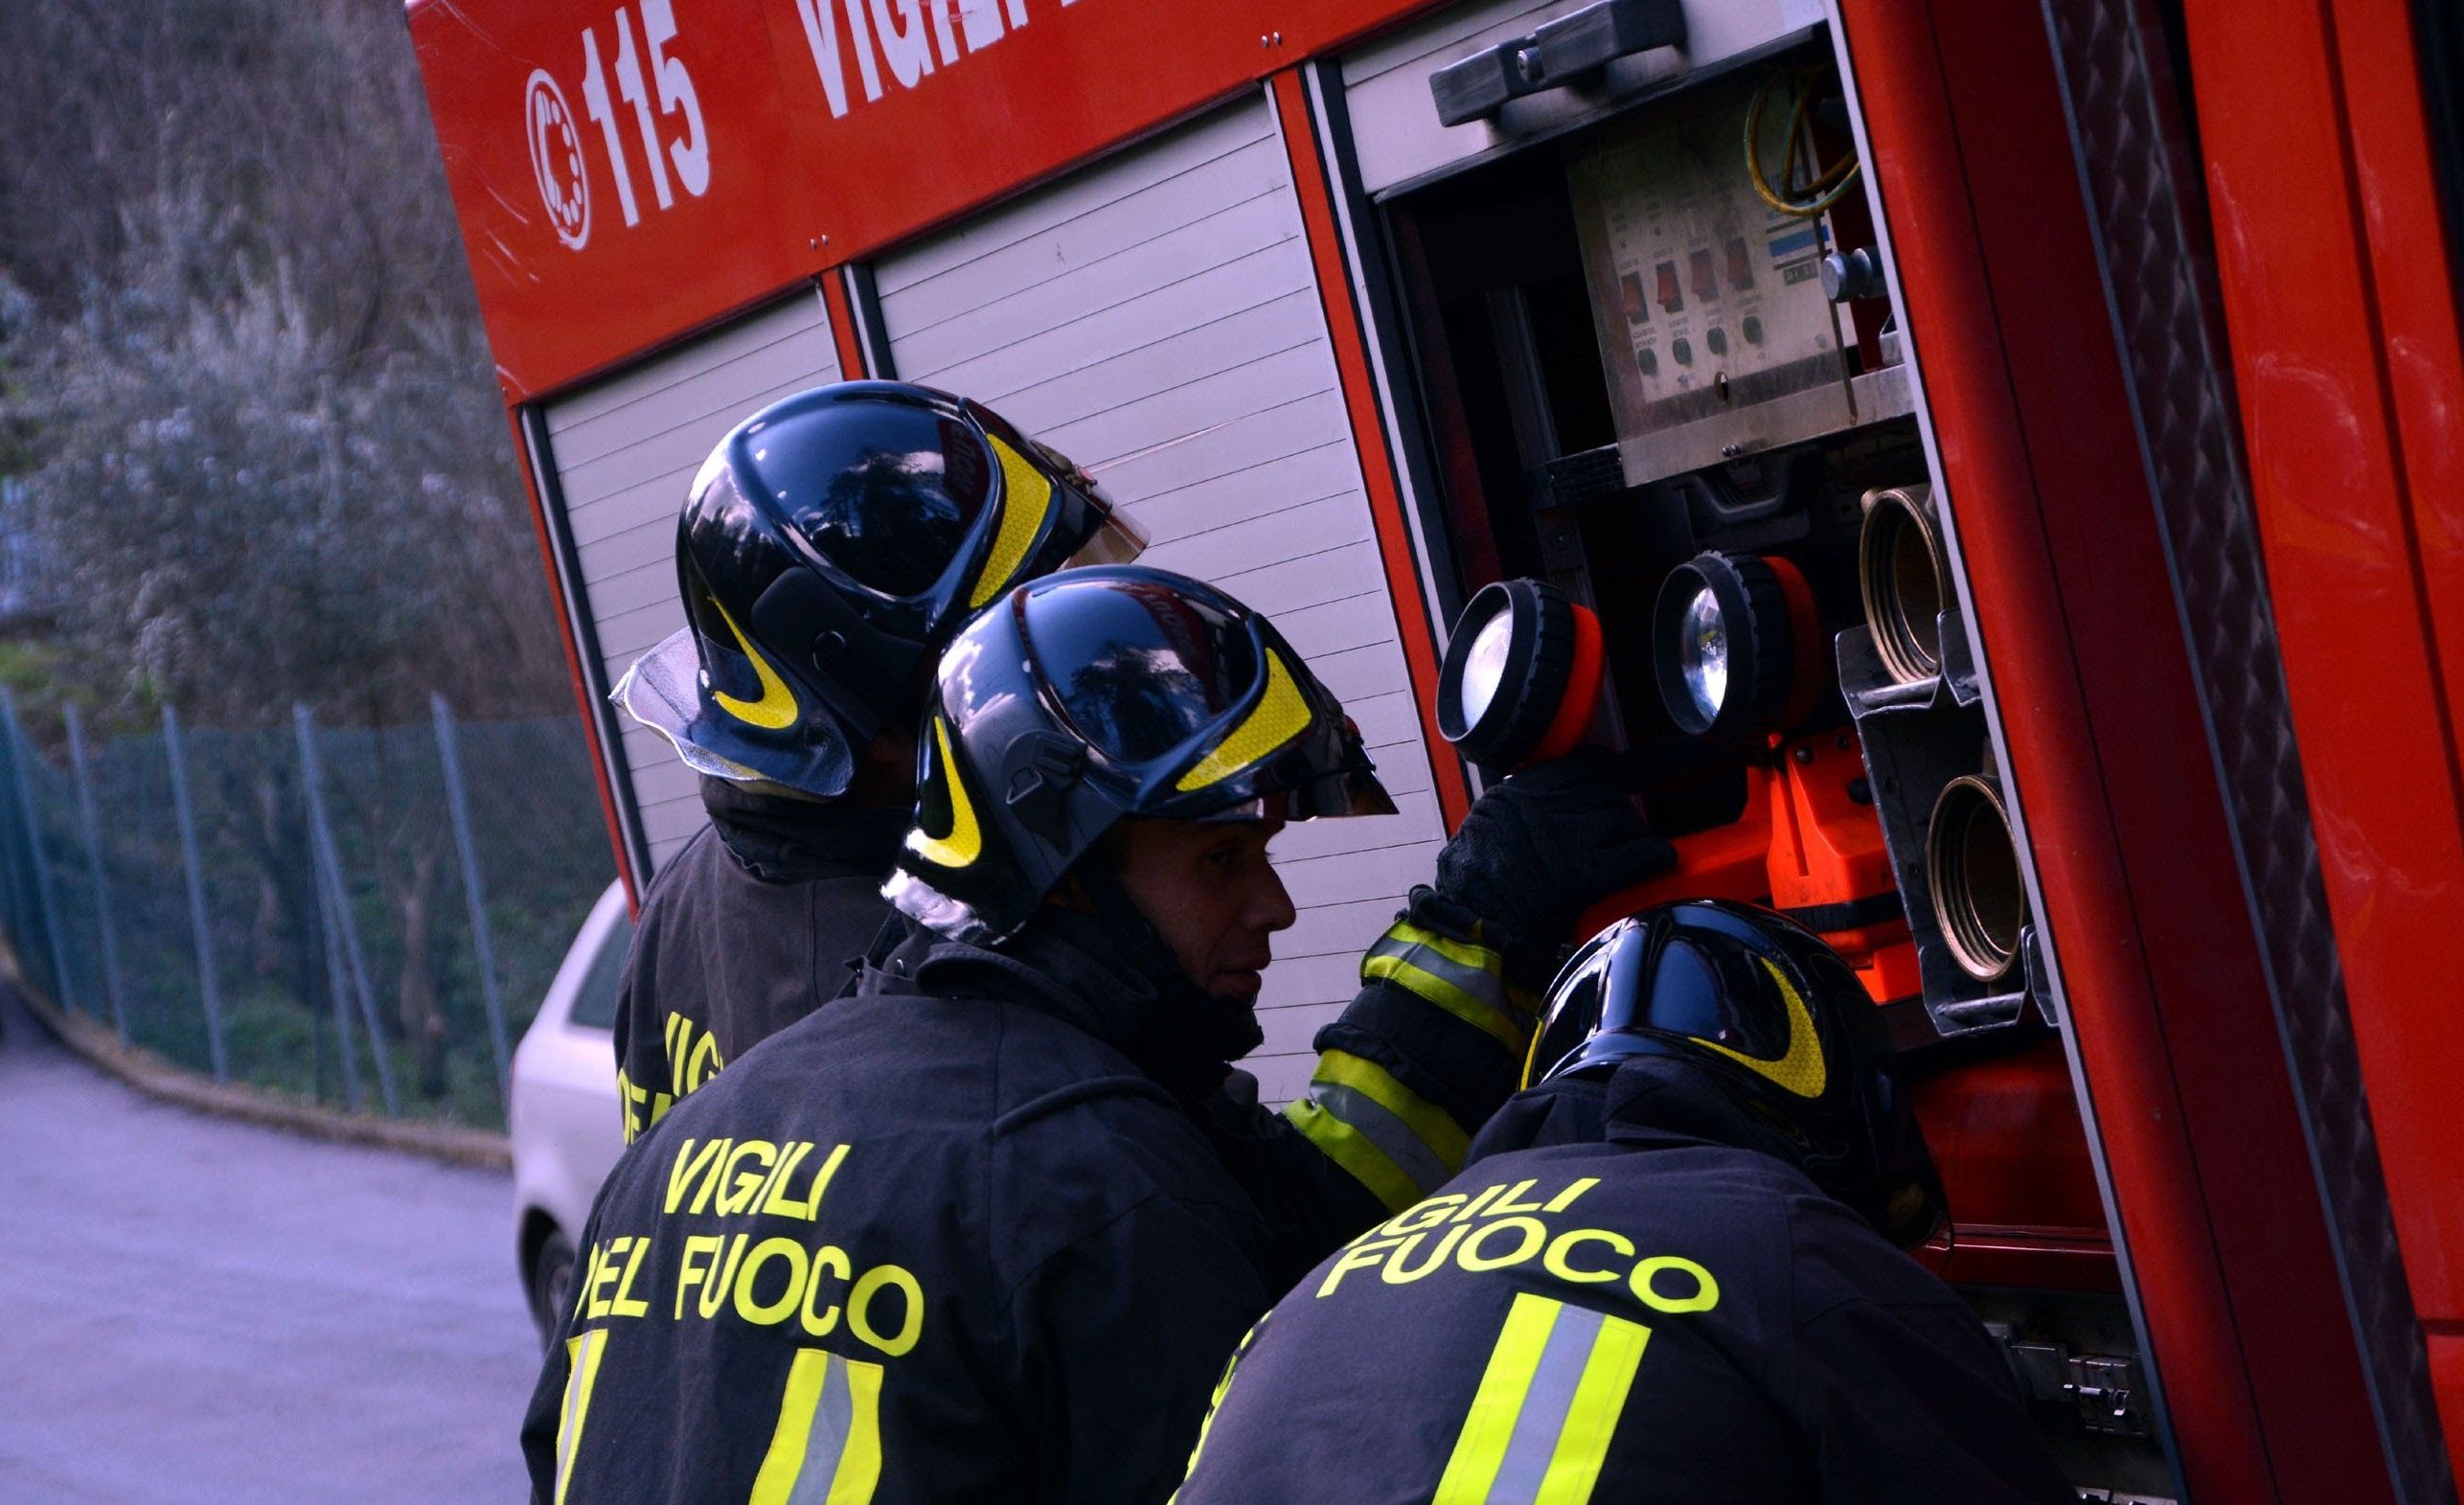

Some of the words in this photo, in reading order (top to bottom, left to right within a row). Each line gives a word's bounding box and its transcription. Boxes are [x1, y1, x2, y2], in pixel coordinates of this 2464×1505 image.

[582, 0, 711, 228] 115
[665, 1011, 723, 1097] VIG
[663, 1137, 852, 1221] VIGILI
[674, 1233, 924, 1357] FUOCO
[1315, 1216, 1720, 1313] FUOCO
